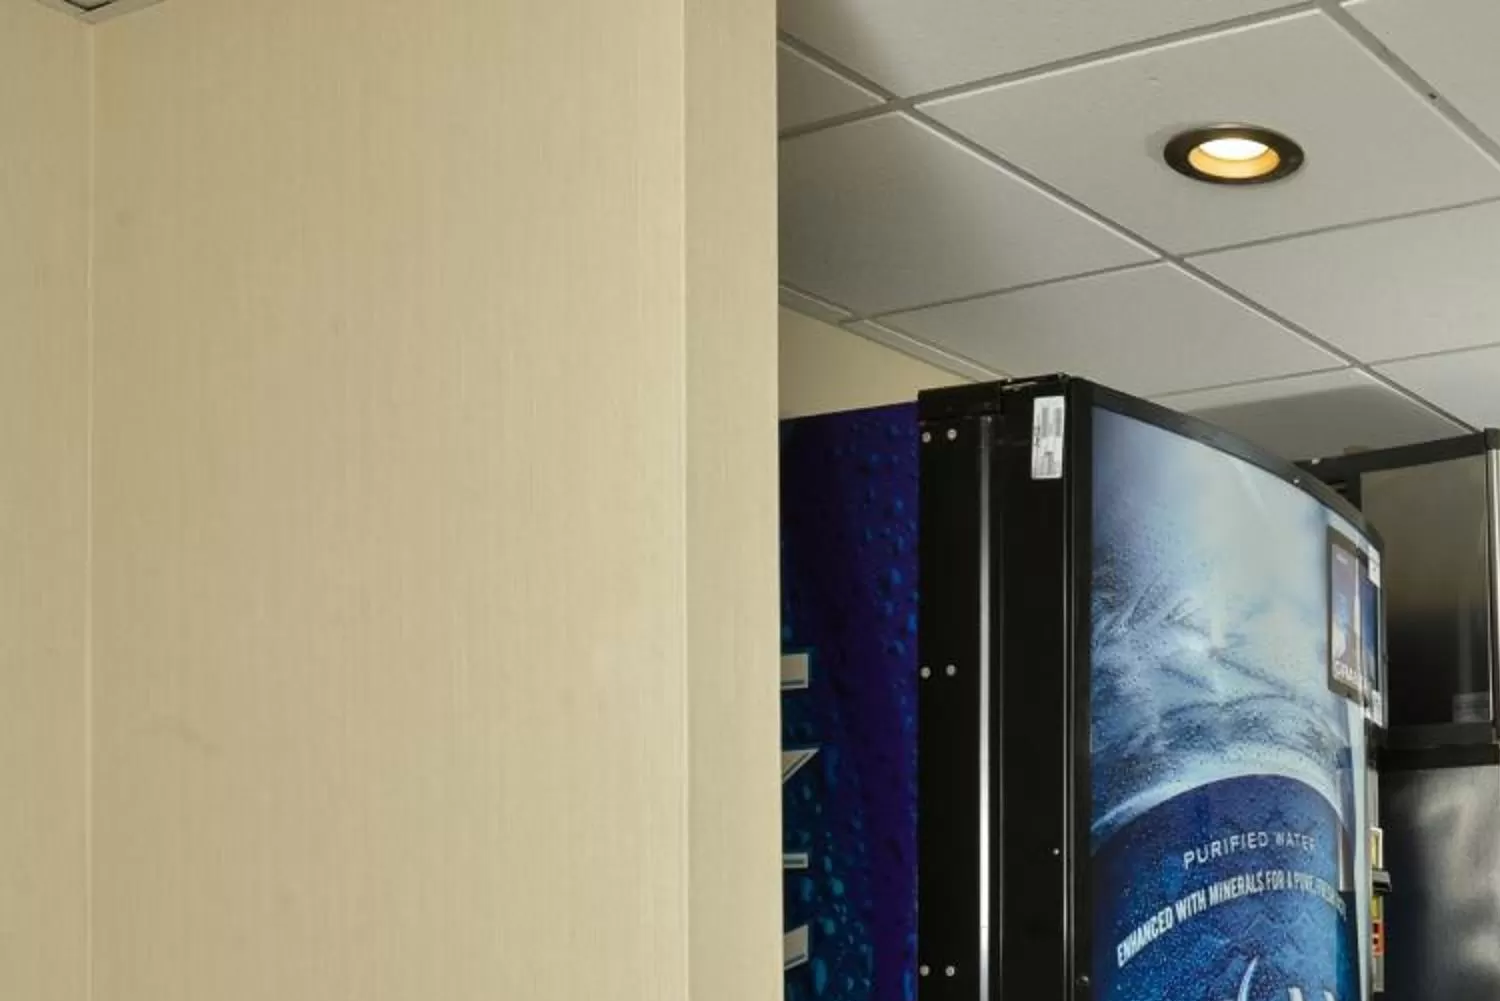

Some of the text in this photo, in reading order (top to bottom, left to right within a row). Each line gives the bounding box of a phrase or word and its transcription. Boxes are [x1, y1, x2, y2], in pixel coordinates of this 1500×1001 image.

[1182, 831, 1318, 871] PURIFIED WATER
[1116, 905, 1174, 969] ENHANCED
[1174, 887, 1207, 923] WITH
[1208, 869, 1265, 907] MINERALS
[1265, 869, 1286, 891] FOR
